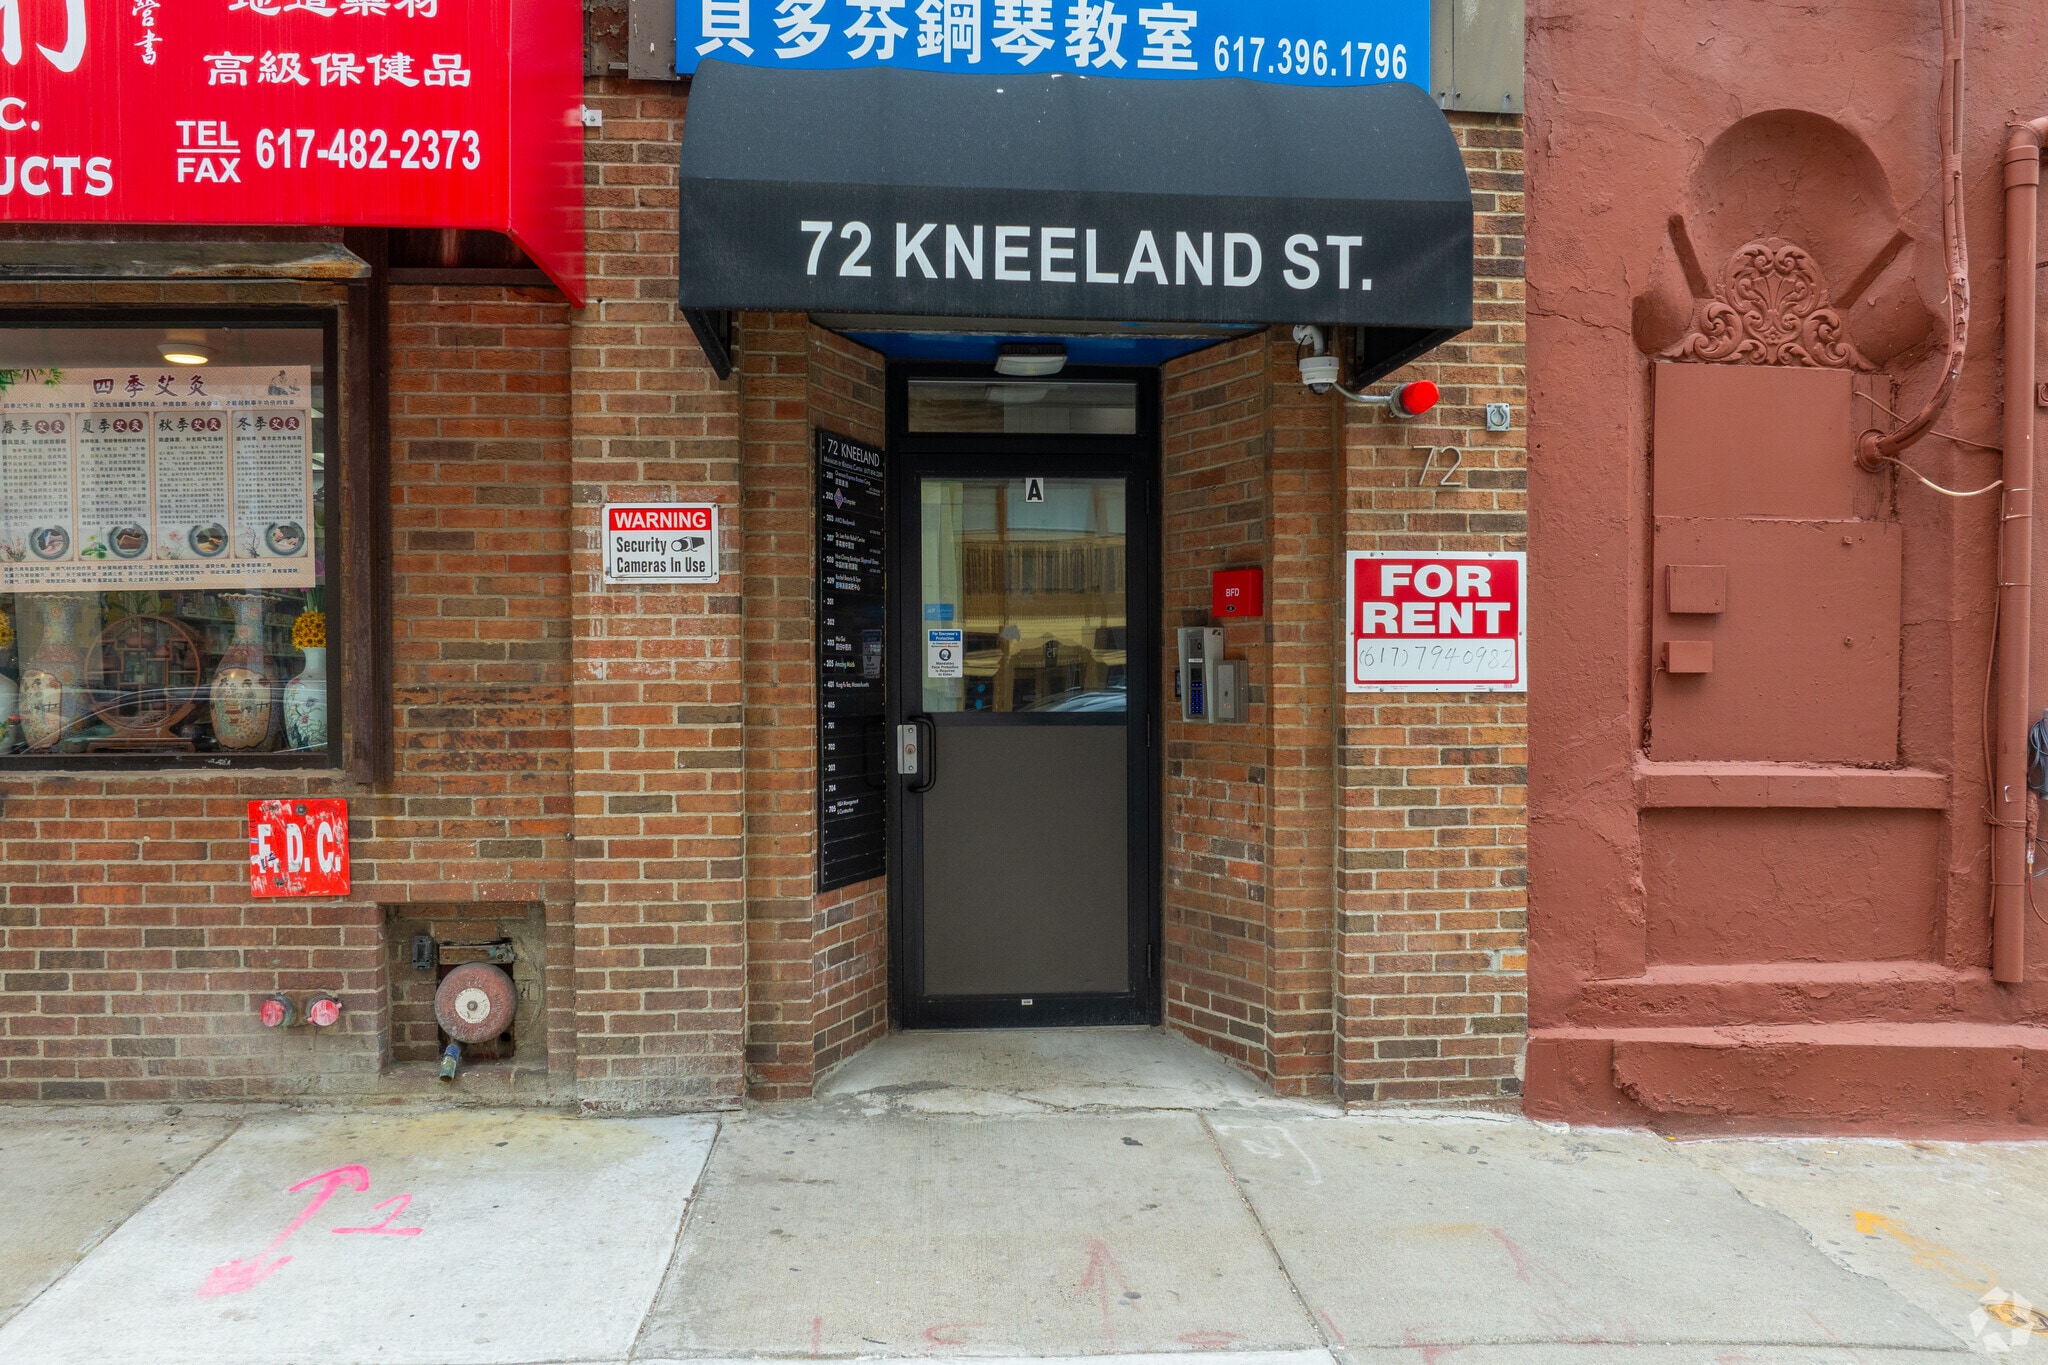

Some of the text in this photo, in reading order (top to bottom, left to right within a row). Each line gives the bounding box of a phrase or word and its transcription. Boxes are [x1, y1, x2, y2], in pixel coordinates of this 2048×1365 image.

[694, 0, 1199, 71] 貝多芬鋼琴教室
[202, 50, 472, 87] 高級保健品
[1213, 34, 1408, 80] 617.396.1796
[175, 120, 239, 147] TEL
[255, 127, 482, 170] 617-482-2373
[176, 157, 242, 184] FAX
[800, 219, 1373, 291] 72 KNEELAND ST.
[92, 374, 209, 398] 四季艾灸
[81, 417, 144, 434] 夏季艾灸
[158, 416, 222, 433] 秋季艾灸
[236, 415, 300, 432] 冬季艾灸
[827, 438, 839, 456] 72
[841, 443, 880, 467] KNEELAND
[1413, 445, 1463, 487] 72
[1027, 479, 1043, 501] A
[613, 511, 707, 529] WARNING
[616, 536, 667, 556] Security
[616, 557, 706, 573] Cameras In Use
[1225, 588, 1240, 597] BFD
[1380, 564, 1492, 597] FOR
[1362, 601, 1511, 634] RENT
